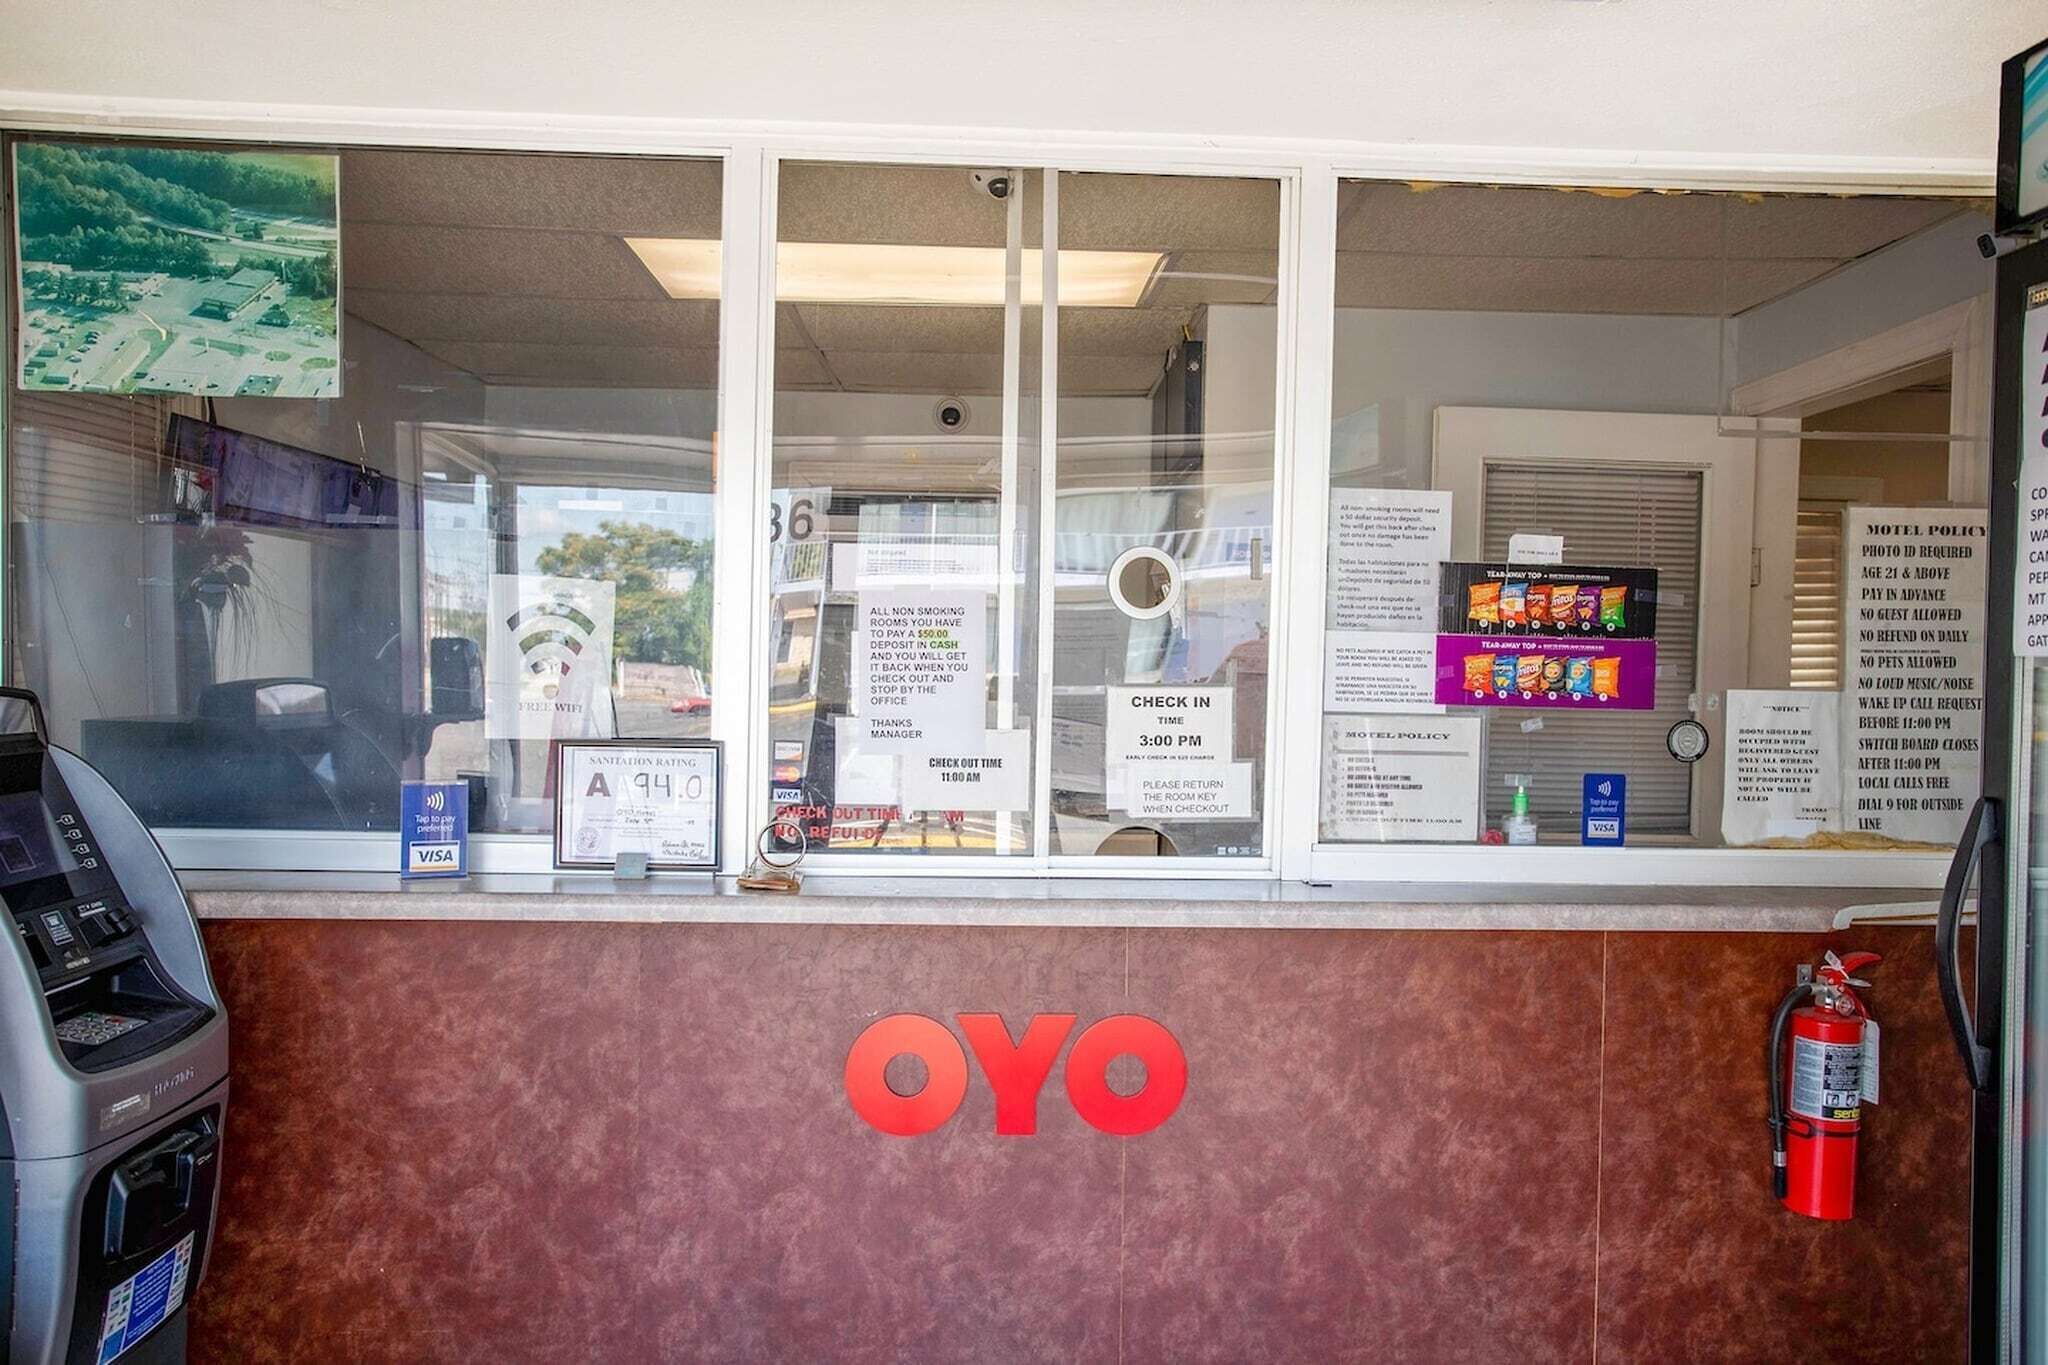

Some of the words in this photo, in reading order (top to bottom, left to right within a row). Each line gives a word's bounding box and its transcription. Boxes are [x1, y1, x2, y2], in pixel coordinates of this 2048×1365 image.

[1866, 525, 1923, 535] MOTEL
[1929, 525, 1986, 536] POLICY
[1862, 545, 1900, 558] PHOTO
[1904, 546, 1916, 558] ID
[1920, 546, 1972, 559] REQUIRED
[1862, 567, 1882, 579] AGE
[1885, 567, 1898, 579] 21
[1914, 567, 1950, 579] ABOVE
[1862, 588, 1883, 600] PAY
[1887, 589, 1897, 600] IN
[1902, 589, 1946, 601] ADVANCE
[870, 607, 890, 616] ALL
[892, 607, 915, 616] NON
[917, 607, 965, 616] SMOKING
[1860, 608, 1874, 621] NO
[1878, 608, 1909, 621] GUEST
[1912, 609, 1962, 621] ALLOWED
[870, 618, 908, 628] ROOMS
[911, 618, 933, 628] YOU
[935, 618, 962, 628] HAVE
[870, 629, 884, 638] TO
[887, 629, 905, 638] PAY
[908, 630, 916, 638] A
[918, 628, 948, 639] $50.00
[1860, 630, 1873, 642] NO
[1877, 630, 1917, 642] REFUND
[1921, 630, 1935, 642] ON
[1938, 630, 1969, 642] DAILY
[870, 640, 915, 650] DEPOSIT
[917, 641, 927, 650] IN
[930, 641, 959, 650] CASH
[870, 652, 892, 661] AND
[894, 652, 917, 661] YOU
[919, 652, 944, 661] WILL
[946, 652, 967, 661] GET
[1860, 656, 1874, 668] NO
[1878, 656, 1902, 668] PETS
[1907, 656, 1957, 668] ALLOWED
[870, 663, 881, 672] IT
[882, 663, 912, 672] BACK
[914, 663, 945, 672] WHEN
[947, 663, 969, 672] YOU
[870, 674, 906, 683] CHECK
[909, 674, 930, 683] OUT
[932, 674, 954, 683] AND
[1858, 677, 1873, 689] NO
[1877, 677, 1904, 689] LOUD
[870, 685, 897, 695] STOP
[900, 685, 915, 695] BY
[917, 686, 937, 695] THE
[870, 697, 908, 706] OFFICE
[1131, 696, 1188, 708] CHECK
[1194, 697, 1210, 708] IN
[1858, 697, 1890, 709] WAKE
[1893, 697, 1906, 710] UP
[1910, 697, 1934, 710] CALL
[1938, 698, 1982, 711] REQUEST
[519, 703, 552, 711] FREE
[555, 703, 583, 713] WIFI
[871, 719, 913, 728] THANKS
[1157, 717, 1184, 725] TIME
[1859, 717, 1899, 729] BEFORE
[1903, 717, 1931, 729] 11:00
[1935, 717, 1951, 729] PM
[871, 730, 923, 739] MANAGER
[1139, 735, 1172, 747] 3:00
[1178, 735, 1202, 747] PM
[1858, 738, 1898, 750] SWITCH
[1902, 738, 1939, 750] BOARD
[1942, 739, 1979, 751] CLOSES
[589, 756, 652, 765] SANITATION
[656, 758, 697, 767] RATING
[929, 758, 959, 768] CHECK
[961, 758, 980, 768] OUT
[981, 758, 1002, 769] TIME
[1858, 757, 1890, 770] AFTER
[1894, 758, 1921, 770] 11:00
[1925, 758, 1941, 770] PM
[941, 772, 965, 783] 11:00
[966, 772, 981, 783] AM
[1858, 776, 1890, 789] LOCAL
[1893, 777, 1923, 789] CALLS
[1926, 777, 1950, 789] FREE
[585, 772, 611, 797] A
[1143, 780, 1181, 789] PLEASE
[1183, 780, 1224, 789] RETURN
[1143, 793, 1163, 801] THE
[1165, 793, 1196, 801] ROOM
[1198, 793, 1217, 801] KEY
[1143, 805, 1173, 813] WHEN
[1174, 804, 1229, 813] CHECKOUT
[1858, 798, 1884, 810] DIAL
[1887, 799, 1893, 810] 9
[1897, 799, 1918, 811] FOR
[1922, 799, 1964, 811] OUTSIDE
[415, 815, 430, 823] Tap
[832, 807, 863, 820] OUT
[417, 824, 453, 834] preferred
[1593, 823, 1615, 832] VISA
[1858, 818, 1882, 830] LINE
[419, 849, 453, 862] VISA
[844, 1012, 1189, 1137] OYO
